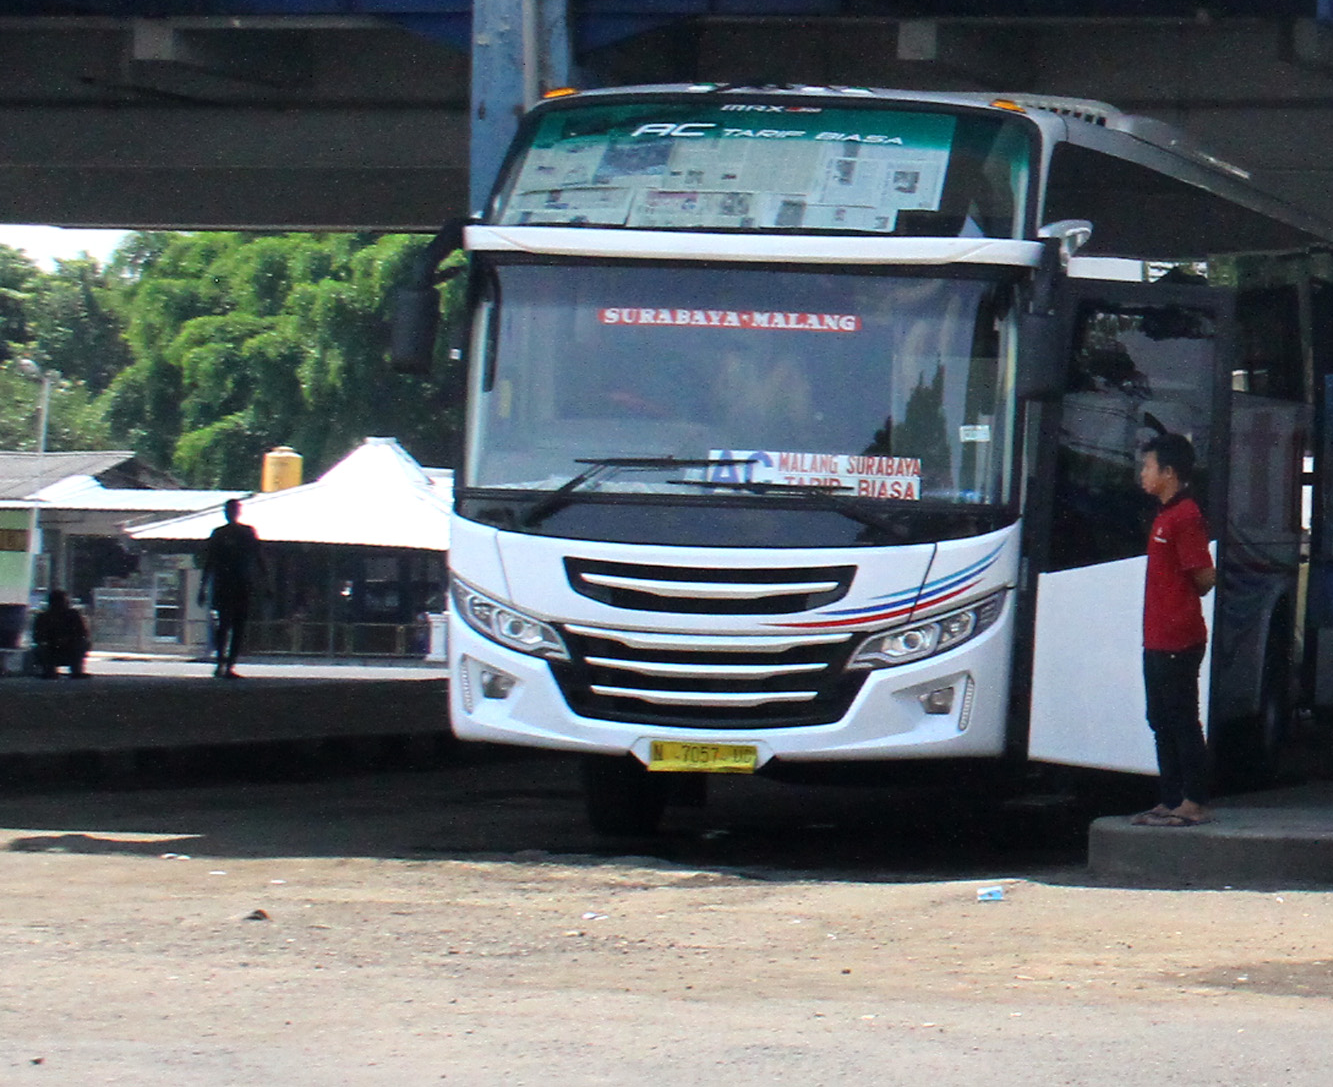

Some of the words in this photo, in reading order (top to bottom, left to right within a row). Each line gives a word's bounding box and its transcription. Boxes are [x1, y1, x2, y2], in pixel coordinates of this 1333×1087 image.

[631, 123, 717, 137] AC
[814, 131, 903, 145] BIASA
[778, 453, 838, 473] MALANG
[846, 457, 922, 476] SURABAYA
[857, 479, 916, 500] BIASA
[653, 743, 664, 761] N
